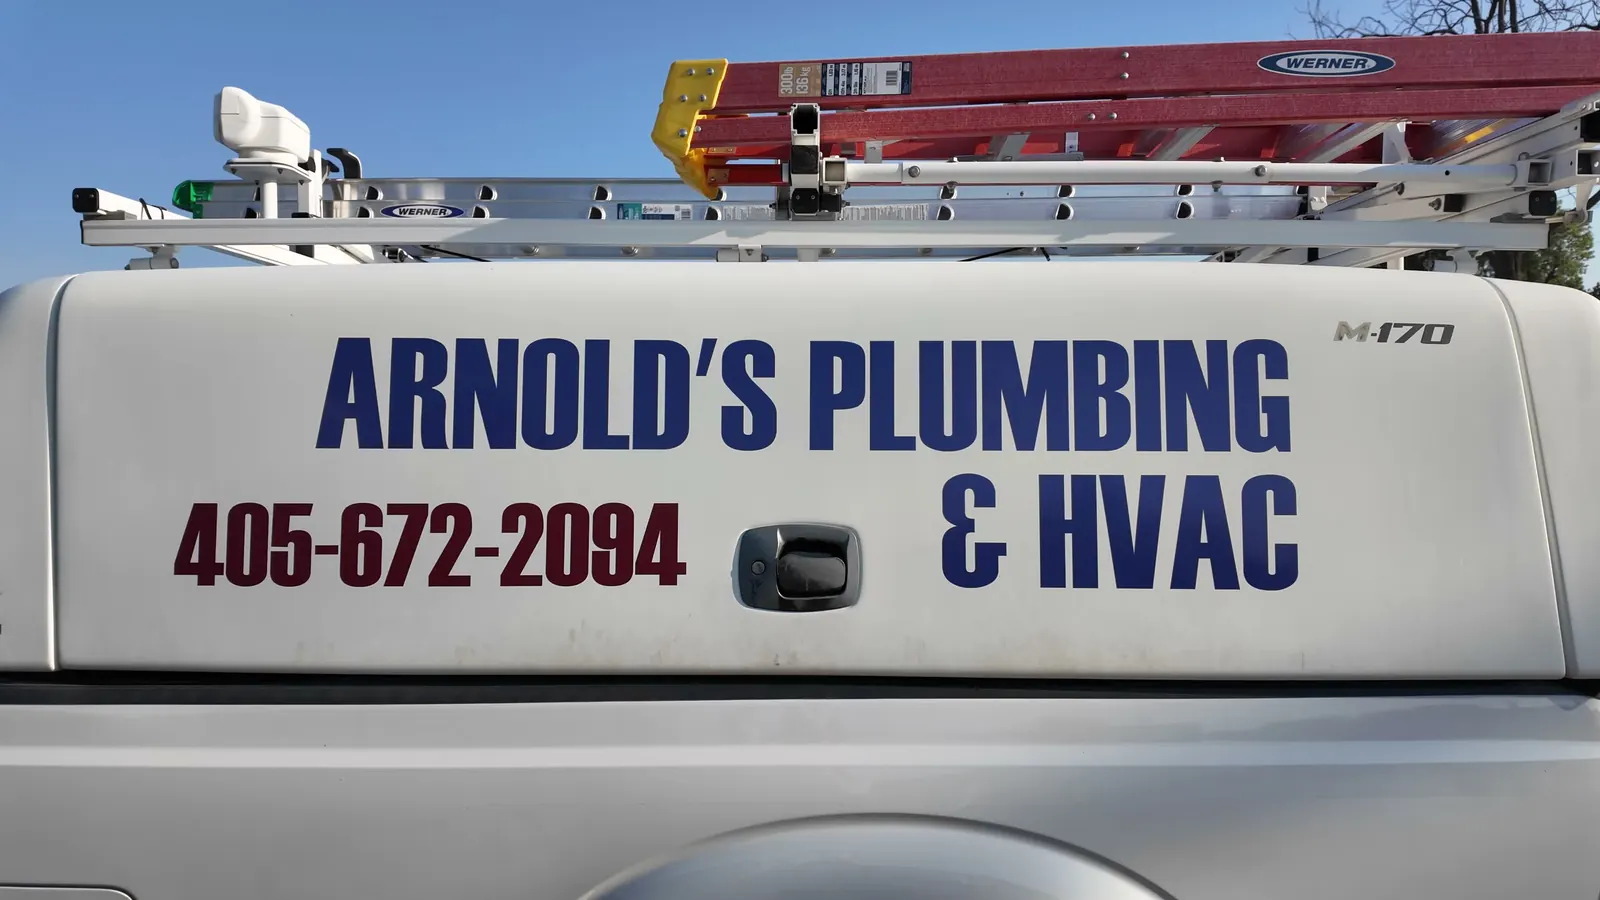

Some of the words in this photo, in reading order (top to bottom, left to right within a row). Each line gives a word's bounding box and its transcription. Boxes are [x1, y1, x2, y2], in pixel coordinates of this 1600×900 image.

[1286, 57, 1368, 69] WERNER
[398, 208, 447, 216] WERNER
[1333, 321, 1455, 345] M-170
[317, 338, 777, 450] ARNOLD'S
[810, 340, 1291, 452] PLUMBING
[174, 502, 687, 587] 405-672-2094
[942, 474, 1007, 588] &
[1040, 474, 1299, 590] HVAC
